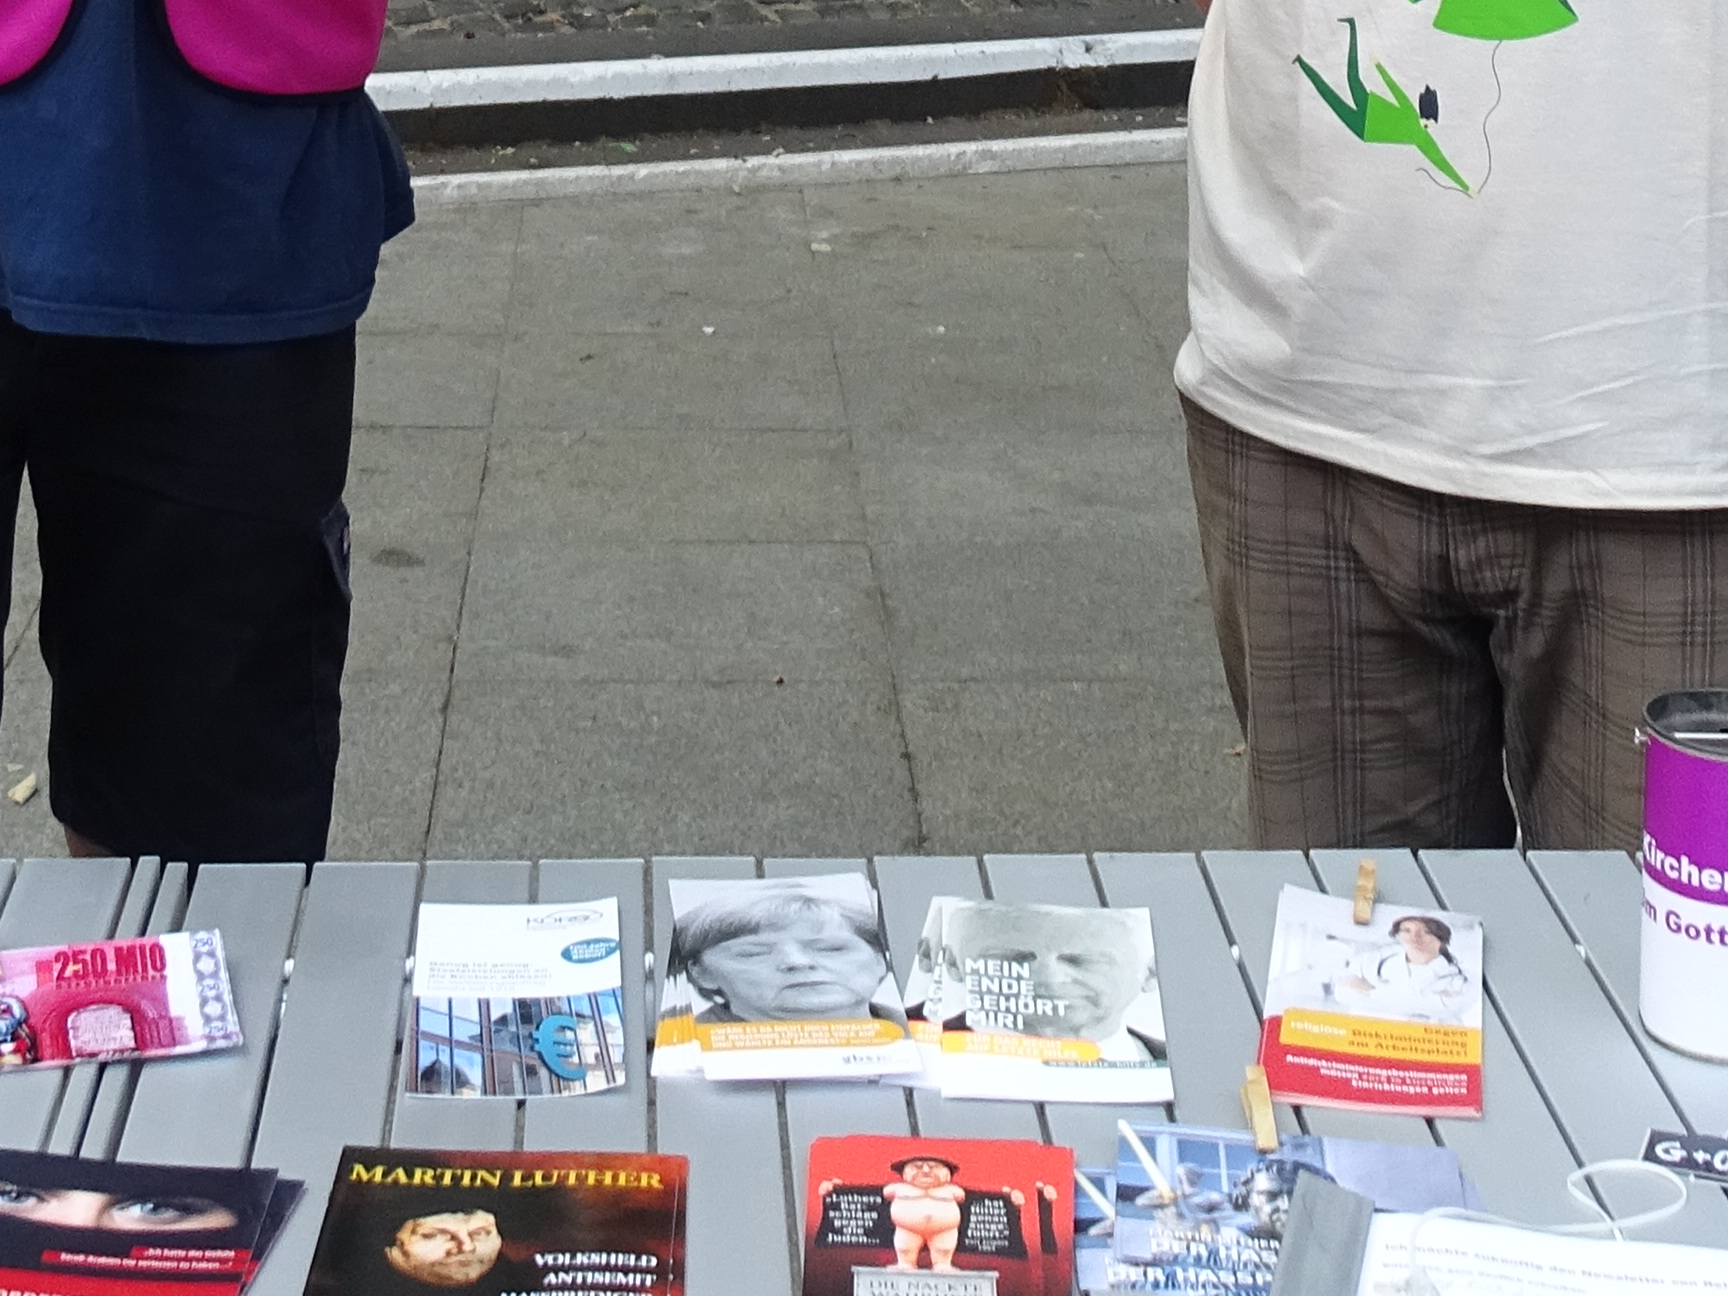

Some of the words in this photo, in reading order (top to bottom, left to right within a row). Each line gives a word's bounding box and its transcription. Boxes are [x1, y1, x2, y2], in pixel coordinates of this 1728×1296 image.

[54, 948, 108, 981] 250
[114, 942, 166, 976] MIO
[965, 957, 1030, 978] MEIN
[965, 975, 1035, 996] ENDE
[965, 992, 1069, 1017] GEHÖRT
[349, 1162, 502, 1189] MARTIN
[509, 1168, 664, 1190] LUTHER
[534, 1251, 659, 1269] VOLKSHELD
[542, 1271, 658, 1287] ANTISEMIT
